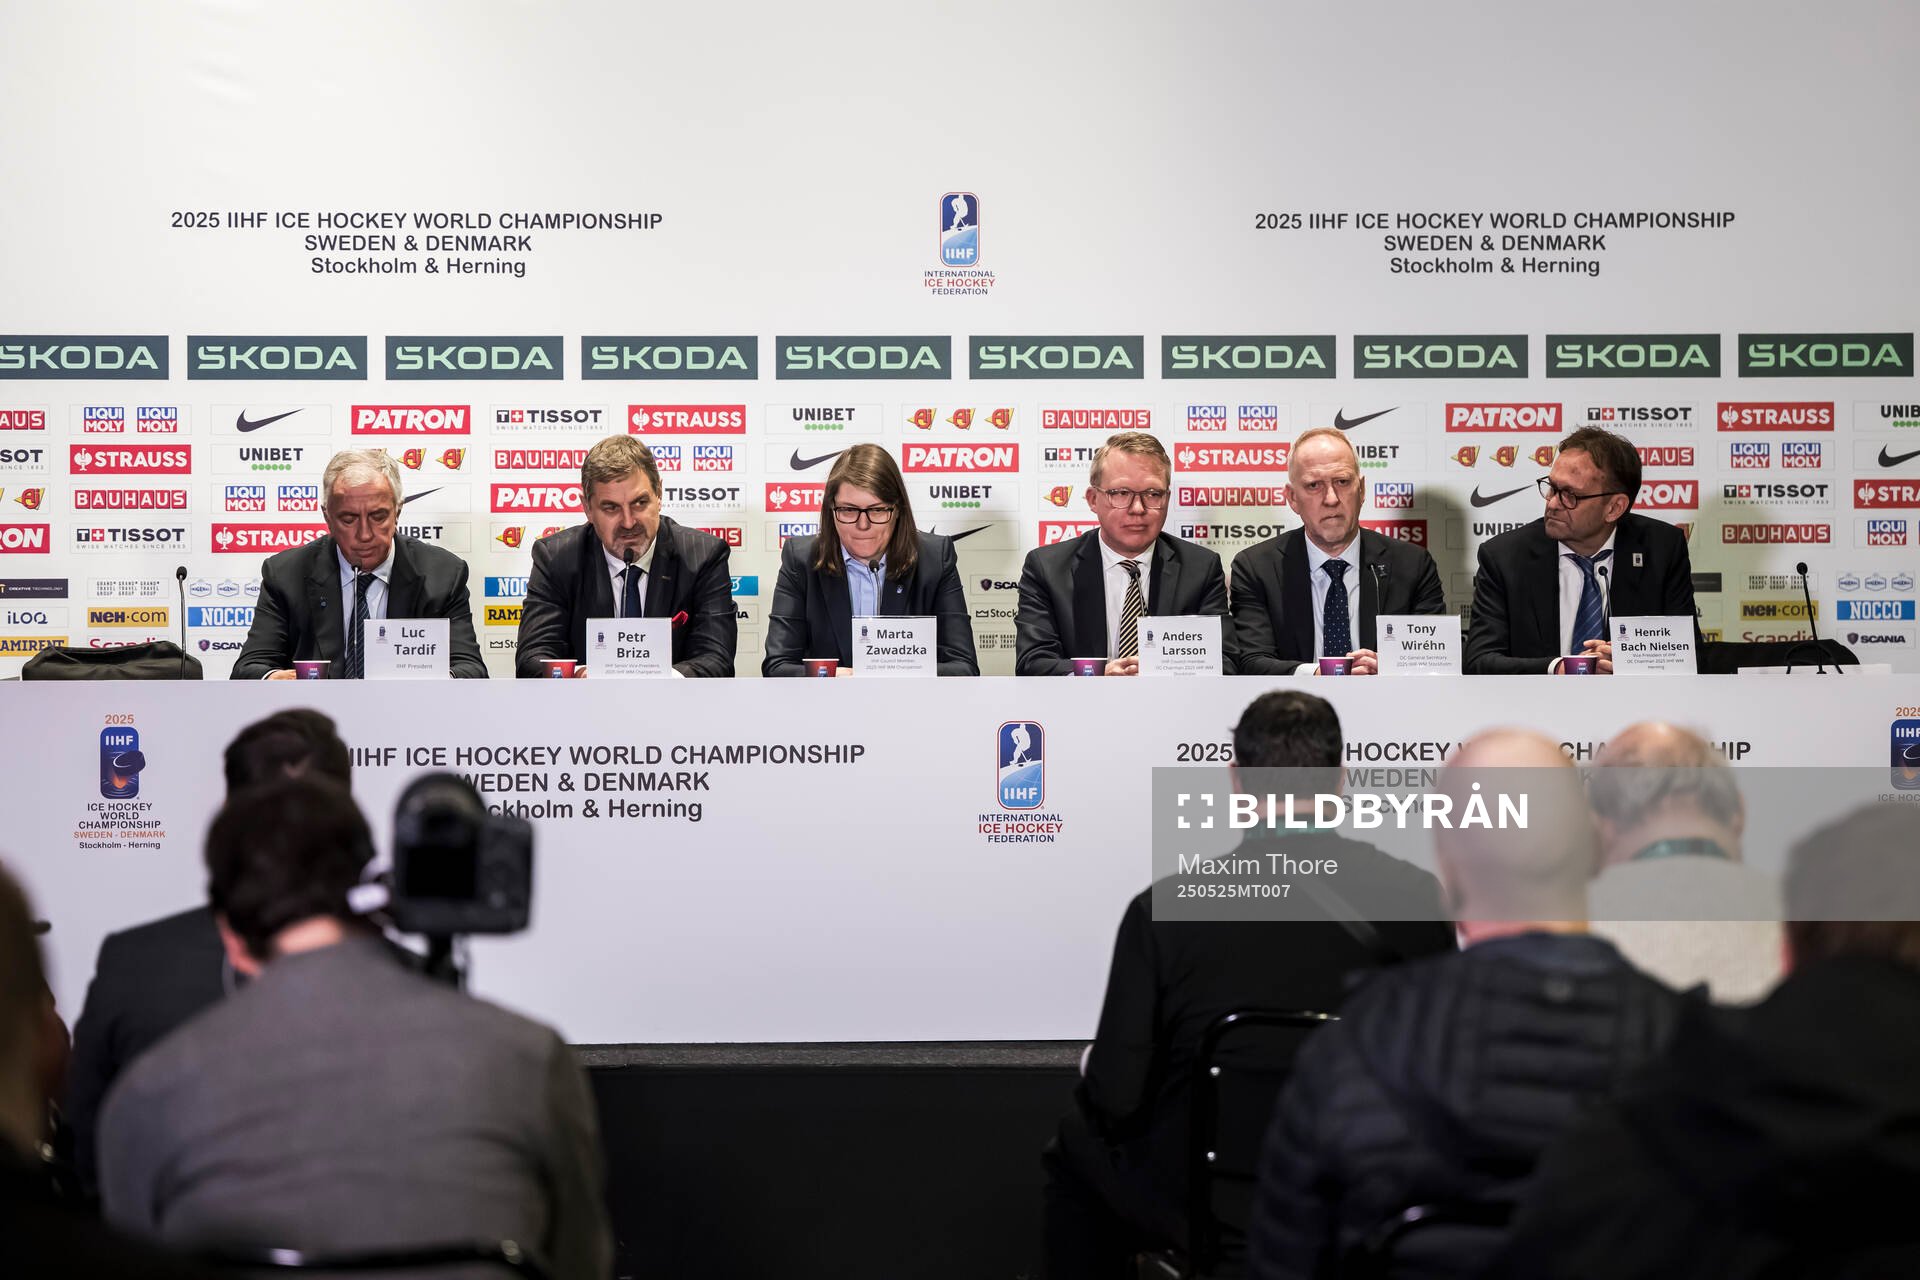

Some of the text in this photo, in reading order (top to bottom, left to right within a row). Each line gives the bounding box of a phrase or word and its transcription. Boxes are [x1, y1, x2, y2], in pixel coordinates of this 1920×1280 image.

[171, 212, 663, 230] 2025 IIHF ICE HOCKEY WORLD CHAMPIONSHIP
[1255, 212, 1737, 230] 2025 IIHF ICE HOCKEY WORLD CHAMPIONSHIP
[304, 235, 532, 252] SWEDEN & DENMARK
[1384, 234, 1607, 252] SWEDEN & DENMARK
[945, 247, 975, 260] IIHF
[311, 257, 527, 279] Stockholm & Herning
[1390, 257, 1601, 278] Stockholm & Herning
[924, 270, 996, 278] INTERNATIONAL
[924, 279, 996, 288] ICE HOCKEY
[932, 288, 989, 296] FEDERATION
[84, 407, 124, 420] LIQUI
[138, 407, 177, 420] LIQUI
[527, 410, 602, 423] TISSOT
[792, 408, 855, 421] UNIBET
[1188, 406, 1226, 418] LIQUI
[1239, 406, 1277, 418] LIQUI
[1452, 407, 1557, 429] PATRON
[1617, 408, 1692, 420] TISSOT
[1741, 409, 1830, 425] STRAUSS
[357, 409, 465, 431] PATRON
[652, 411, 742, 428] STRAUSS
[1044, 410, 1150, 428] BAUHAUS
[1188, 419, 1226, 431] MOLY
[1239, 419, 1277, 431] MOLY
[84, 420, 124, 432] MOLY
[138, 420, 177, 432] MOLY
[239, 447, 303, 461] UNIBET
[694, 446, 732, 458] LIQUI
[1732, 443, 1770, 456] LIQUI
[1783, 443, 1821, 456] LIQUI
[94, 451, 188, 467] STRAUSS
[908, 447, 1014, 467] PATRON
[1198, 450, 1288, 465] STRAUSS
[1732, 456, 1770, 468] MOLY
[1783, 456, 1821, 468] MOLY
[694, 459, 732, 471] MOLY
[226, 486, 265, 499] LIQUI
[279, 486, 318, 499] LIQUI
[665, 488, 740, 501] TISSOT
[930, 486, 992, 499] UNIBET
[1376, 483, 1413, 496] LIQUI
[1755, 484, 1829, 498] TISSOT
[77, 491, 186, 507] BAUHAUS
[1181, 489, 1286, 505] BAUHAUS
[1376, 496, 1413, 508] MOLY
[226, 500, 265, 512] MOLY
[279, 500, 318, 512] MOLY
[781, 524, 817, 536] LIQUI
[1210, 525, 1285, 538] TISSOT
[1868, 520, 1906, 532] LIQUI
[108, 528, 185, 542] TISSOT
[1723, 526, 1830, 542] BAUHAUS
[1868, 533, 1906, 545] MOLY
[200, 607, 255, 626] NOCCO
[1850, 601, 1902, 620] NOCCO
[402, 626, 425, 638] Luc
[877, 629, 913, 640] Marta
[1407, 624, 1436, 636] Tony
[1634, 627, 1671, 637] Henrik
[618, 631, 646, 643] Petr
[1162, 631, 1203, 642] Anders
[1860, 634, 1906, 644] SCANIA
[394, 643, 436, 656] Tardif
[866, 644, 927, 656] Zawadzka
[1162, 645, 1207, 656] Larsson
[1402, 640, 1445, 651] Wiréhn
[1621, 642, 1689, 652] Bach Nielsen
[617, 647, 651, 659] Briza
[105, 714, 134, 724] 2025
[105, 735, 134, 746] IIHF
[406, 747, 447, 766] ICE
[456, 746, 561, 766] HOCKEY
[569, 746, 663, 765] WORLD
[669, 745, 865, 764] CHAMPIONSHIP
[1176, 742, 1451, 762] 2025 HOCKEY
[557, 772, 575, 792] &
[584, 771, 710, 791] DENMARK
[1004, 787, 1038, 800] IIHF
[1878, 794, 1895, 802] ICE
[87, 802, 153, 811] ICE HOCKEY
[582, 799, 600, 818] &
[609, 799, 702, 822] Herning
[100, 812, 140, 820] WORLD
[978, 814, 1063, 822] INTERNATIONAL
[78, 821, 161, 829] CHAMPIONSHIP
[979, 823, 1063, 833] ICE HOCKEY
[74, 830, 166, 839] SWEDEN DENMARK
[988, 835, 1055, 843] FEDERATION
[79, 841, 161, 850] Stockholm Herning
